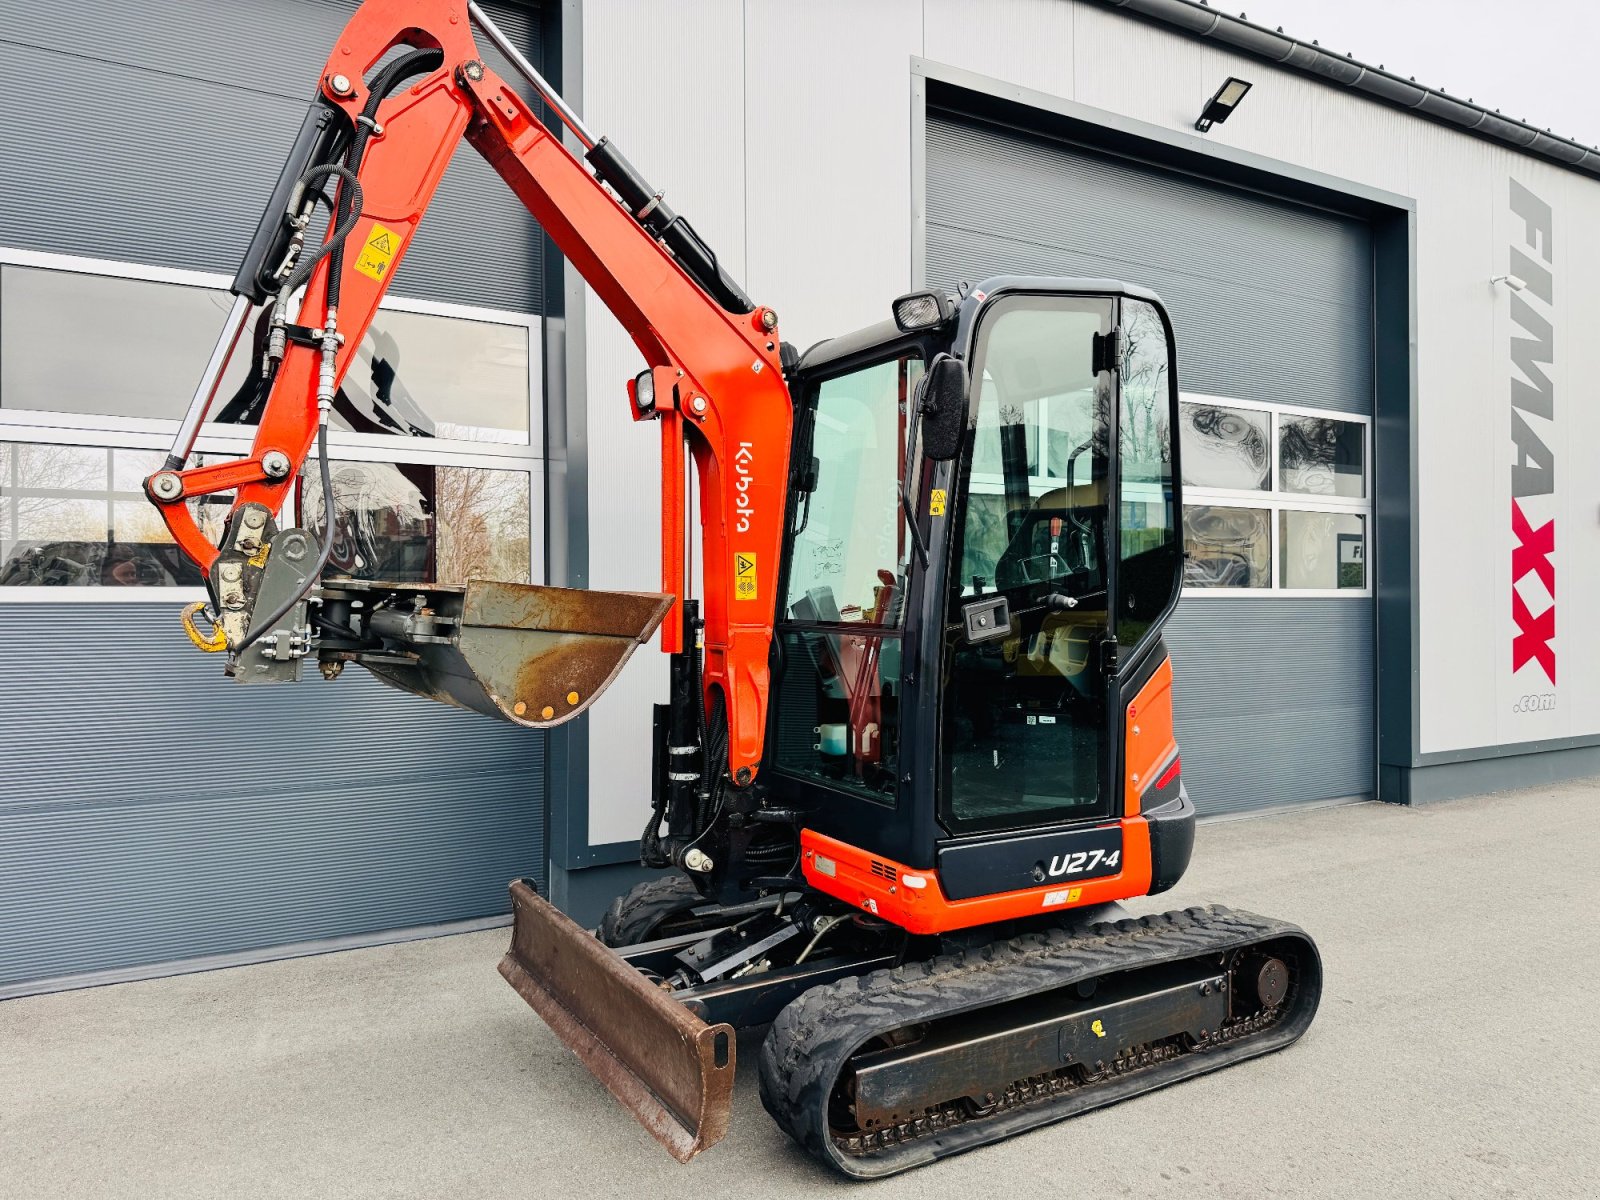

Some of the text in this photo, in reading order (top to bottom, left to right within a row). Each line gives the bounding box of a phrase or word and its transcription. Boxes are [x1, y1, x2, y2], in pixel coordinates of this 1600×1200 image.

[1509, 176, 1556, 687] FIMAXX
[735, 441, 754, 533] Kubota
[1512, 693, 1556, 714] .com
[1048, 849, 1120, 877] U27-4
